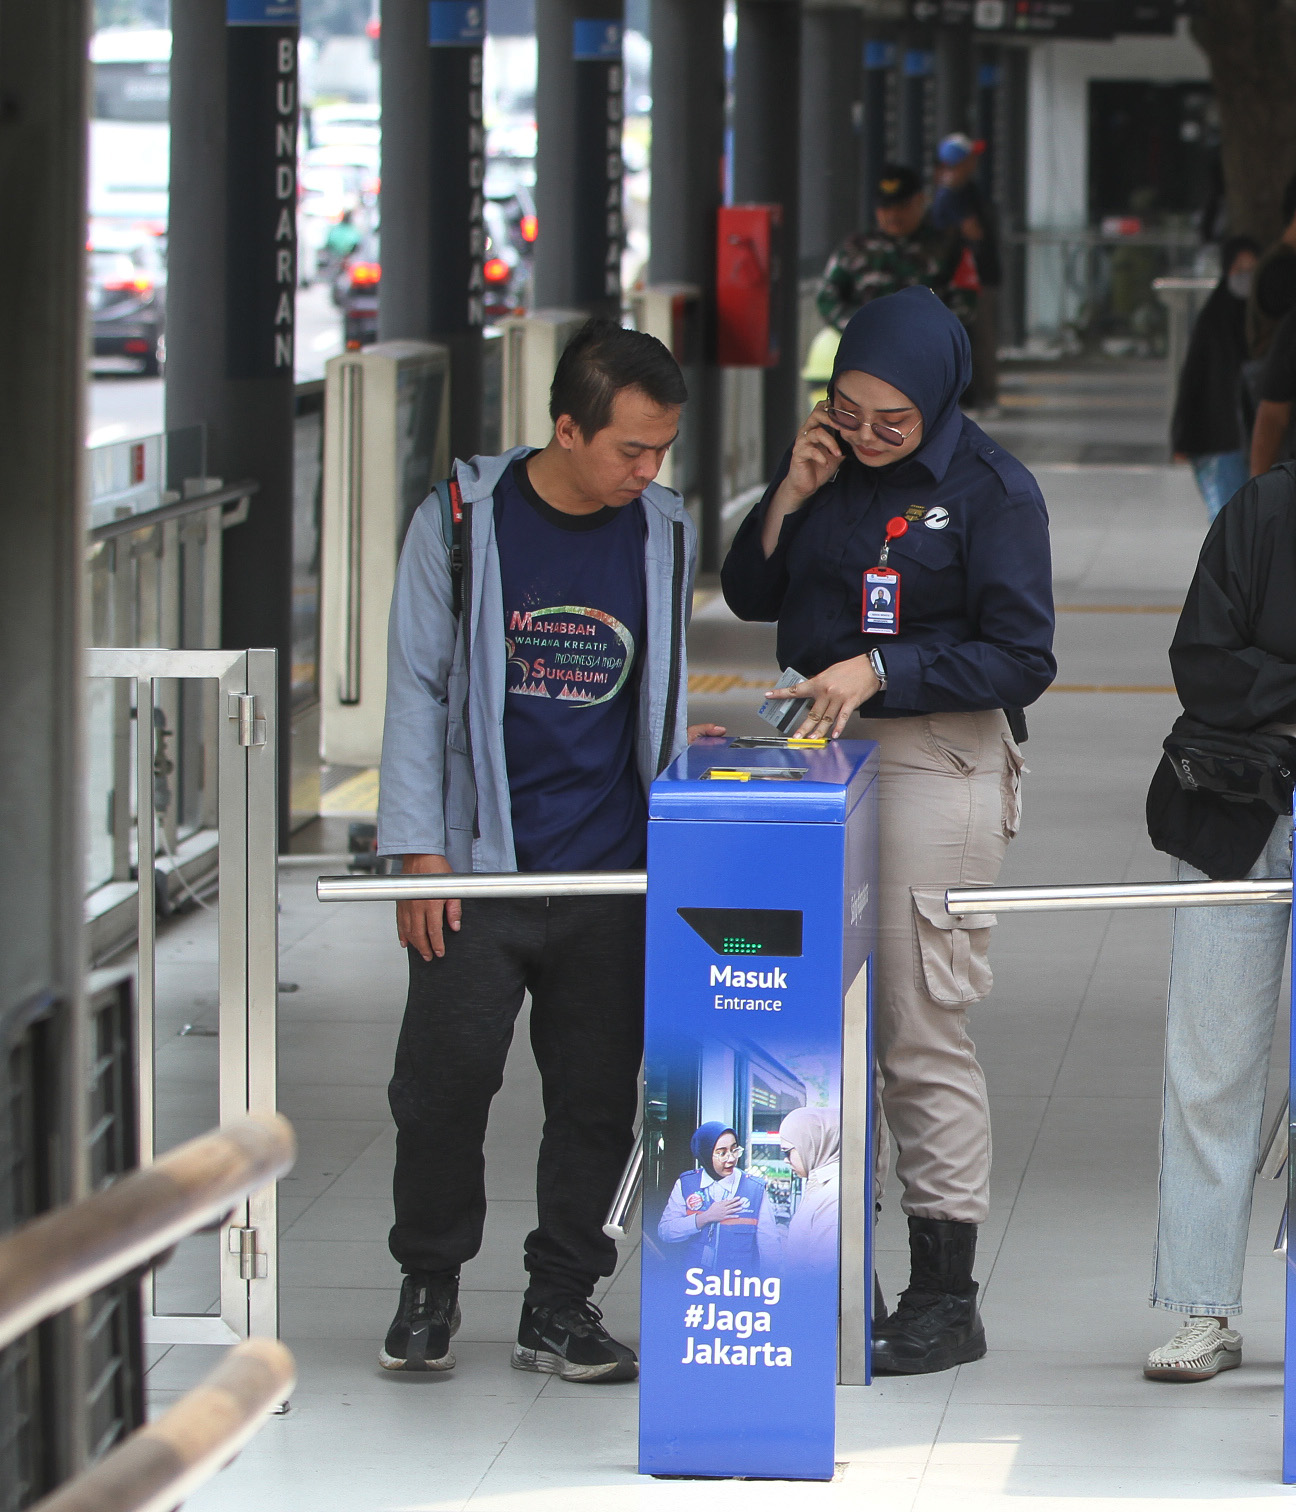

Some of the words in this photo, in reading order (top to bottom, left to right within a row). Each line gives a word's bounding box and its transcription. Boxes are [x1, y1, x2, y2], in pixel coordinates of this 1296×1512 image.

[274, 38, 294, 368] BUNDARAN
[468, 56, 483, 326] BUNDARAN
[509, 611, 596, 636] MAHABBAH
[564, 640, 608, 651] KREATIF
[531, 658, 608, 684] SUKABUMI
[554, 653, 600, 667] INDONESIA
[710, 965, 788, 989] Masuk
[714, 995, 782, 1011] Entrance
[685, 1268, 781, 1305] Saling
[684, 1303, 771, 1338] #Jaga
[681, 1337, 793, 1367] Jakarta
